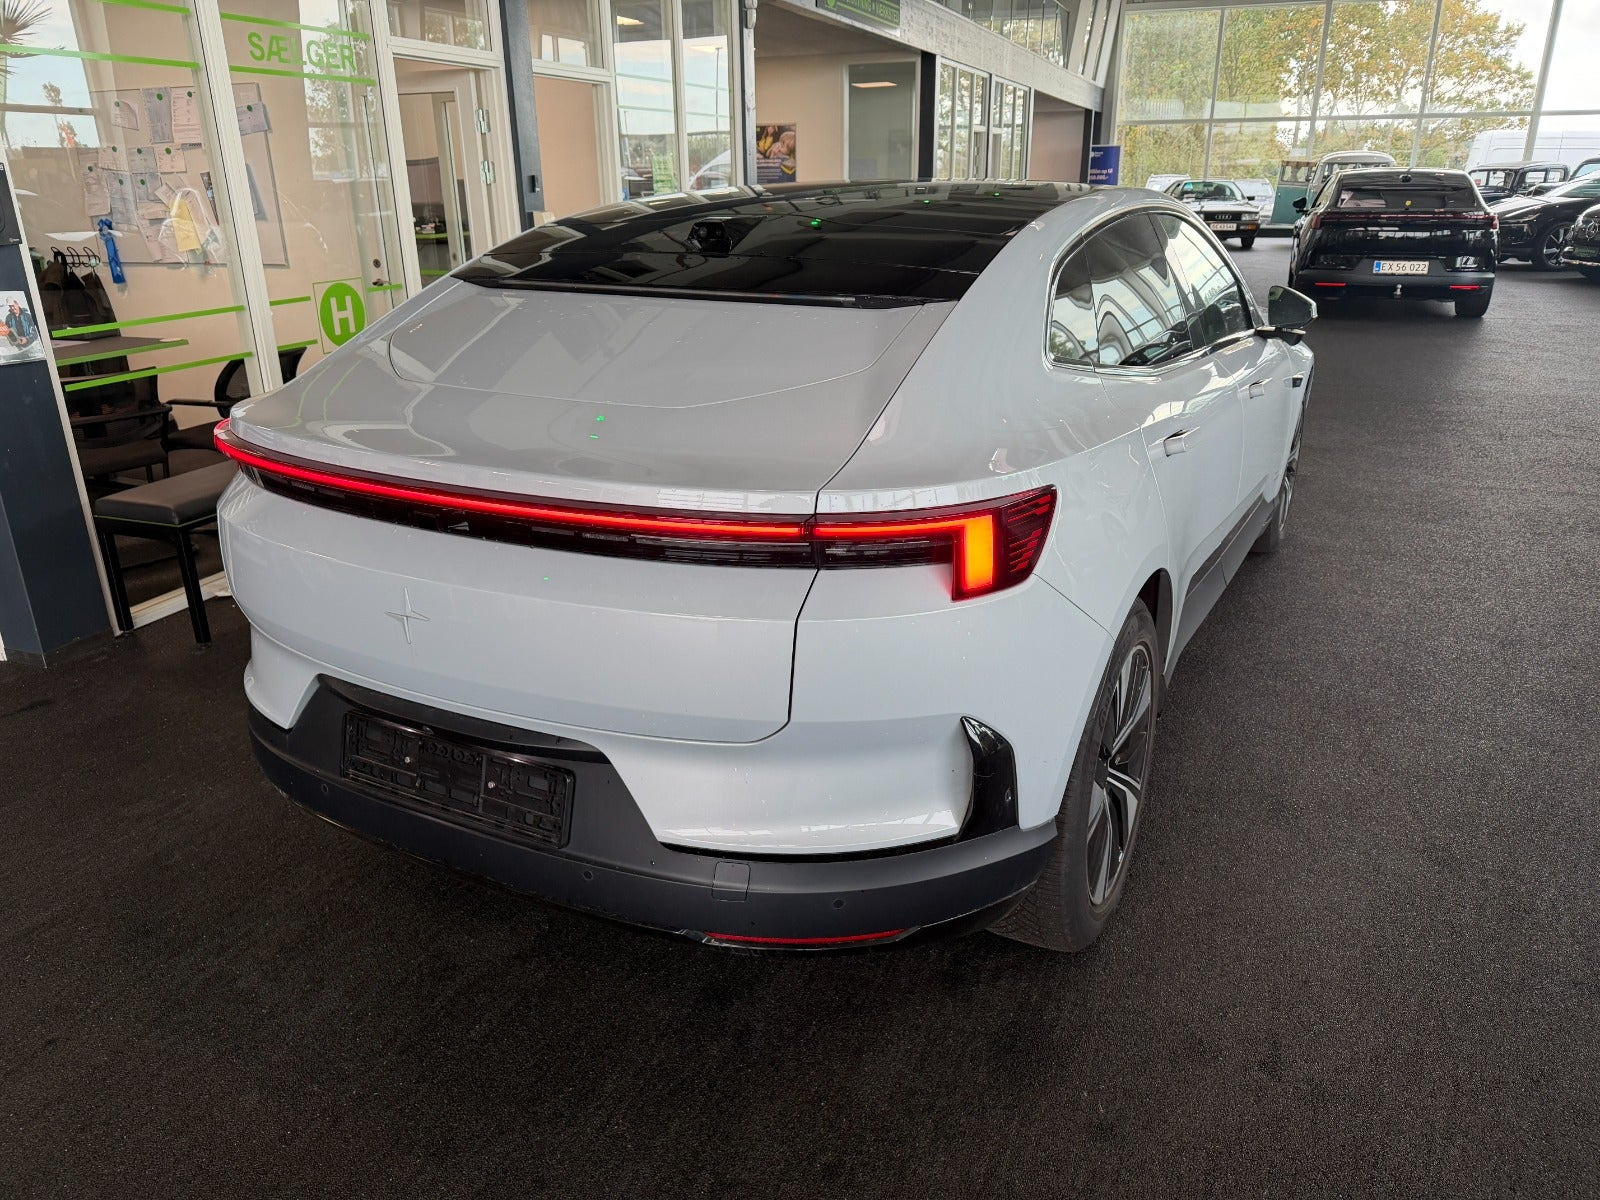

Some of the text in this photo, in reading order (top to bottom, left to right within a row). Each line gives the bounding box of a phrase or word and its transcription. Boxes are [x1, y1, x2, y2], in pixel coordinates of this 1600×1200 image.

[247, 31, 356, 72] SÆLGER
[1381, 262, 1427, 272] EX 56 022
[330, 295, 356, 336] H
